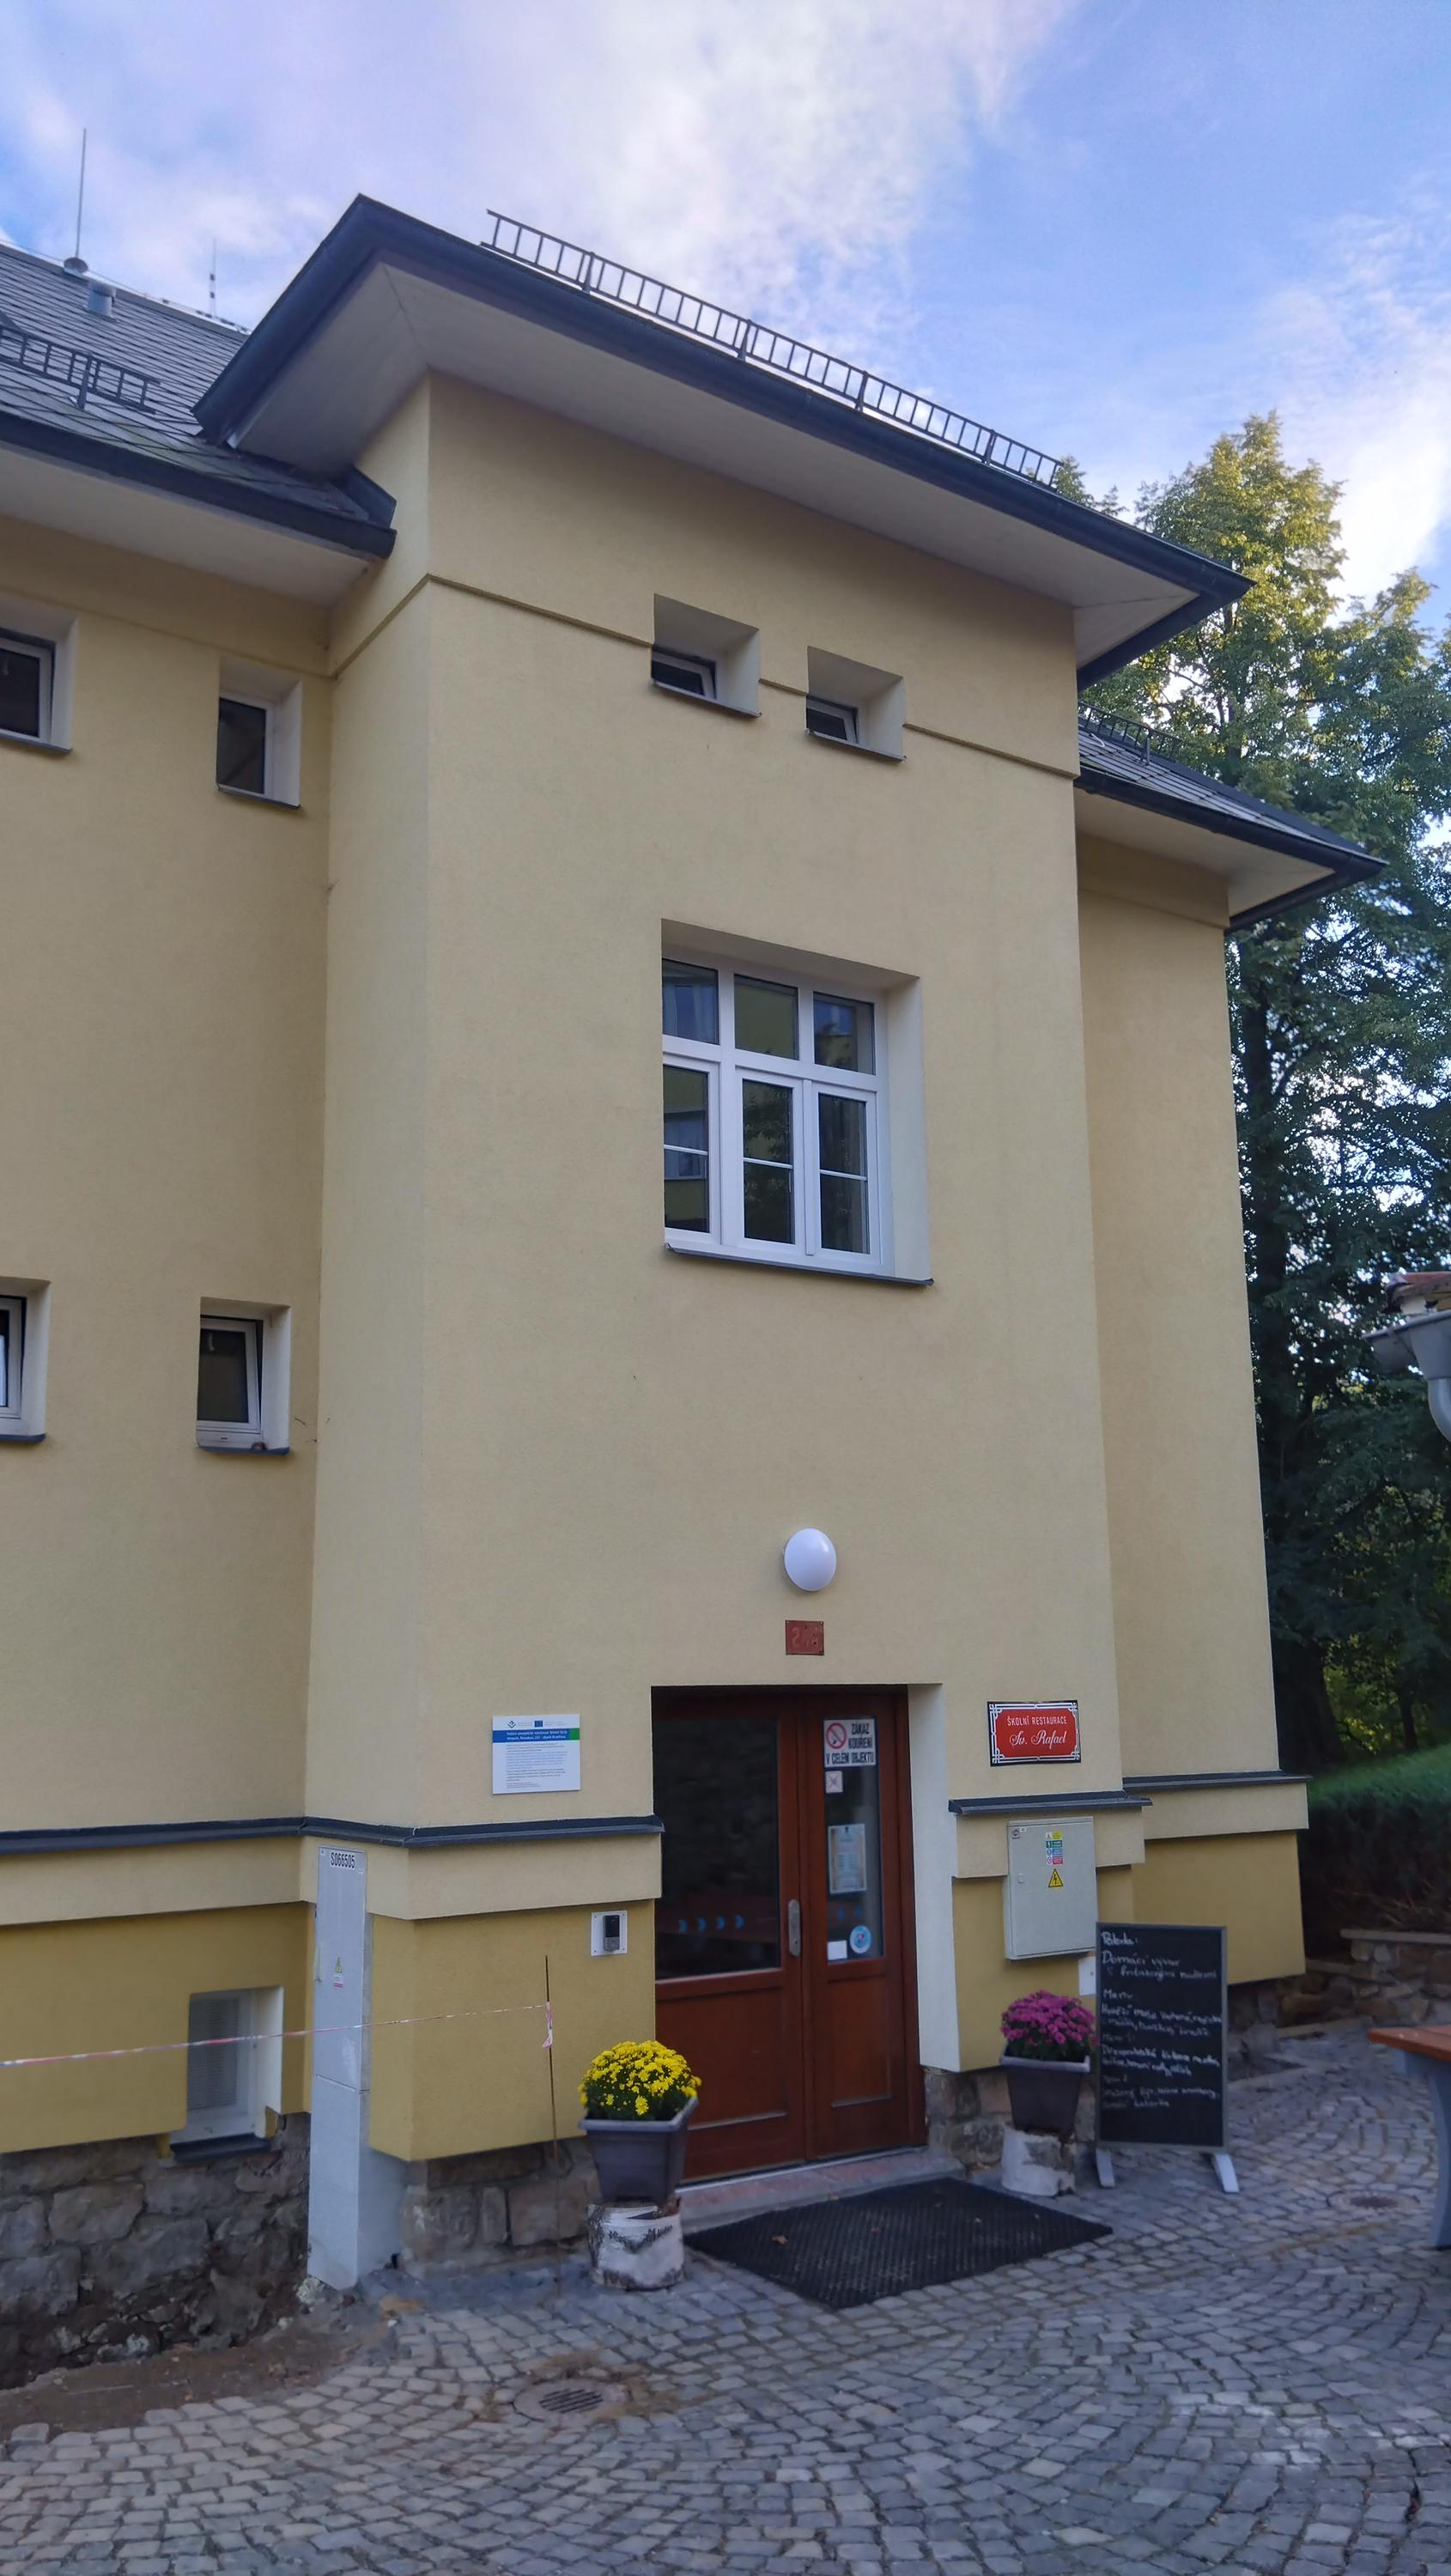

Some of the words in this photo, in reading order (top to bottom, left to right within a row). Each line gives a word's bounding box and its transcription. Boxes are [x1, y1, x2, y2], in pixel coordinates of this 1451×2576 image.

[1007, 1715, 1029, 1726] ŠKOLNÍ
[1031, 1716, 1067, 1726] RESTAURACE
[851, 1722, 870, 1735] ZÁKAZ
[1009, 1730, 1028, 1747] Sv.
[1030, 1729, 1067, 1750] Rafael
[331, 1851, 355, 1868] S066505
